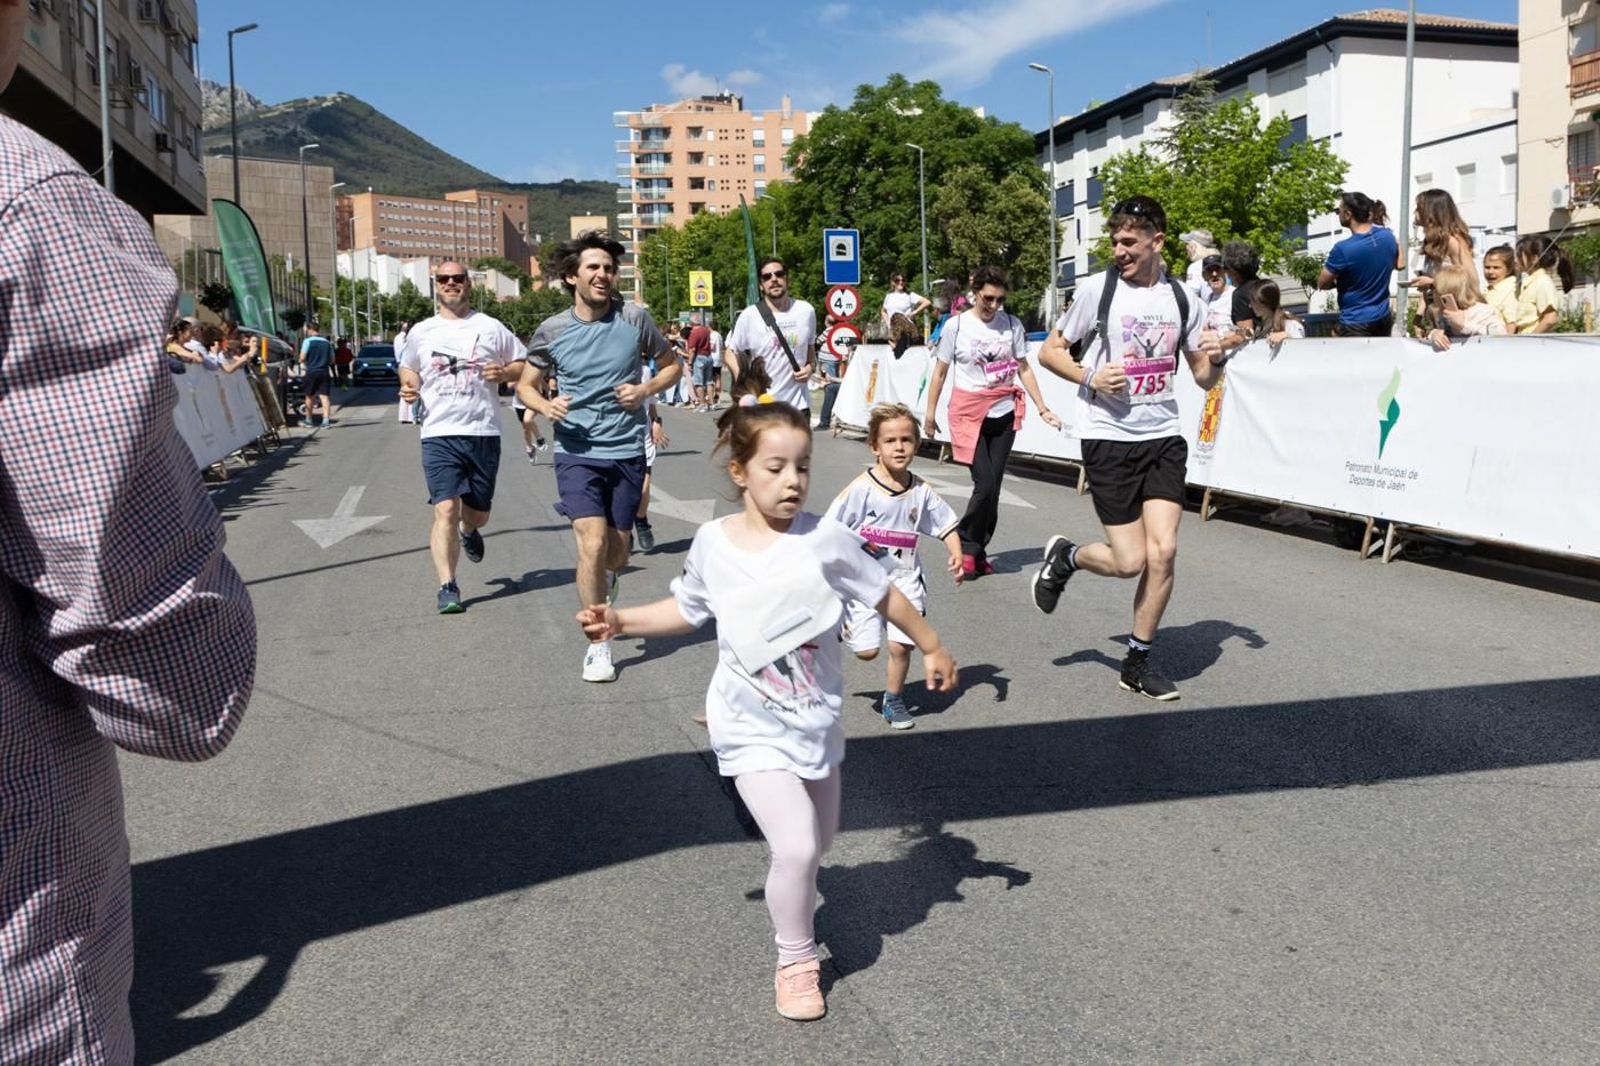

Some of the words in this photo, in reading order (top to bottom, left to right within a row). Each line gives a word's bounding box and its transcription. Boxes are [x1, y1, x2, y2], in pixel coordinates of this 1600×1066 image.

[834, 298, 842, 309] 4
[1133, 374, 1166, 395] 735
[1345, 460, 1372, 474] Patronato
[1373, 463, 1407, 479] Municipal
[1408, 469, 1419, 481] de
[1348, 473, 1375, 488] Deportes
[1376, 478, 1386, 489] de
[1387, 480, 1406, 492] Jaén
